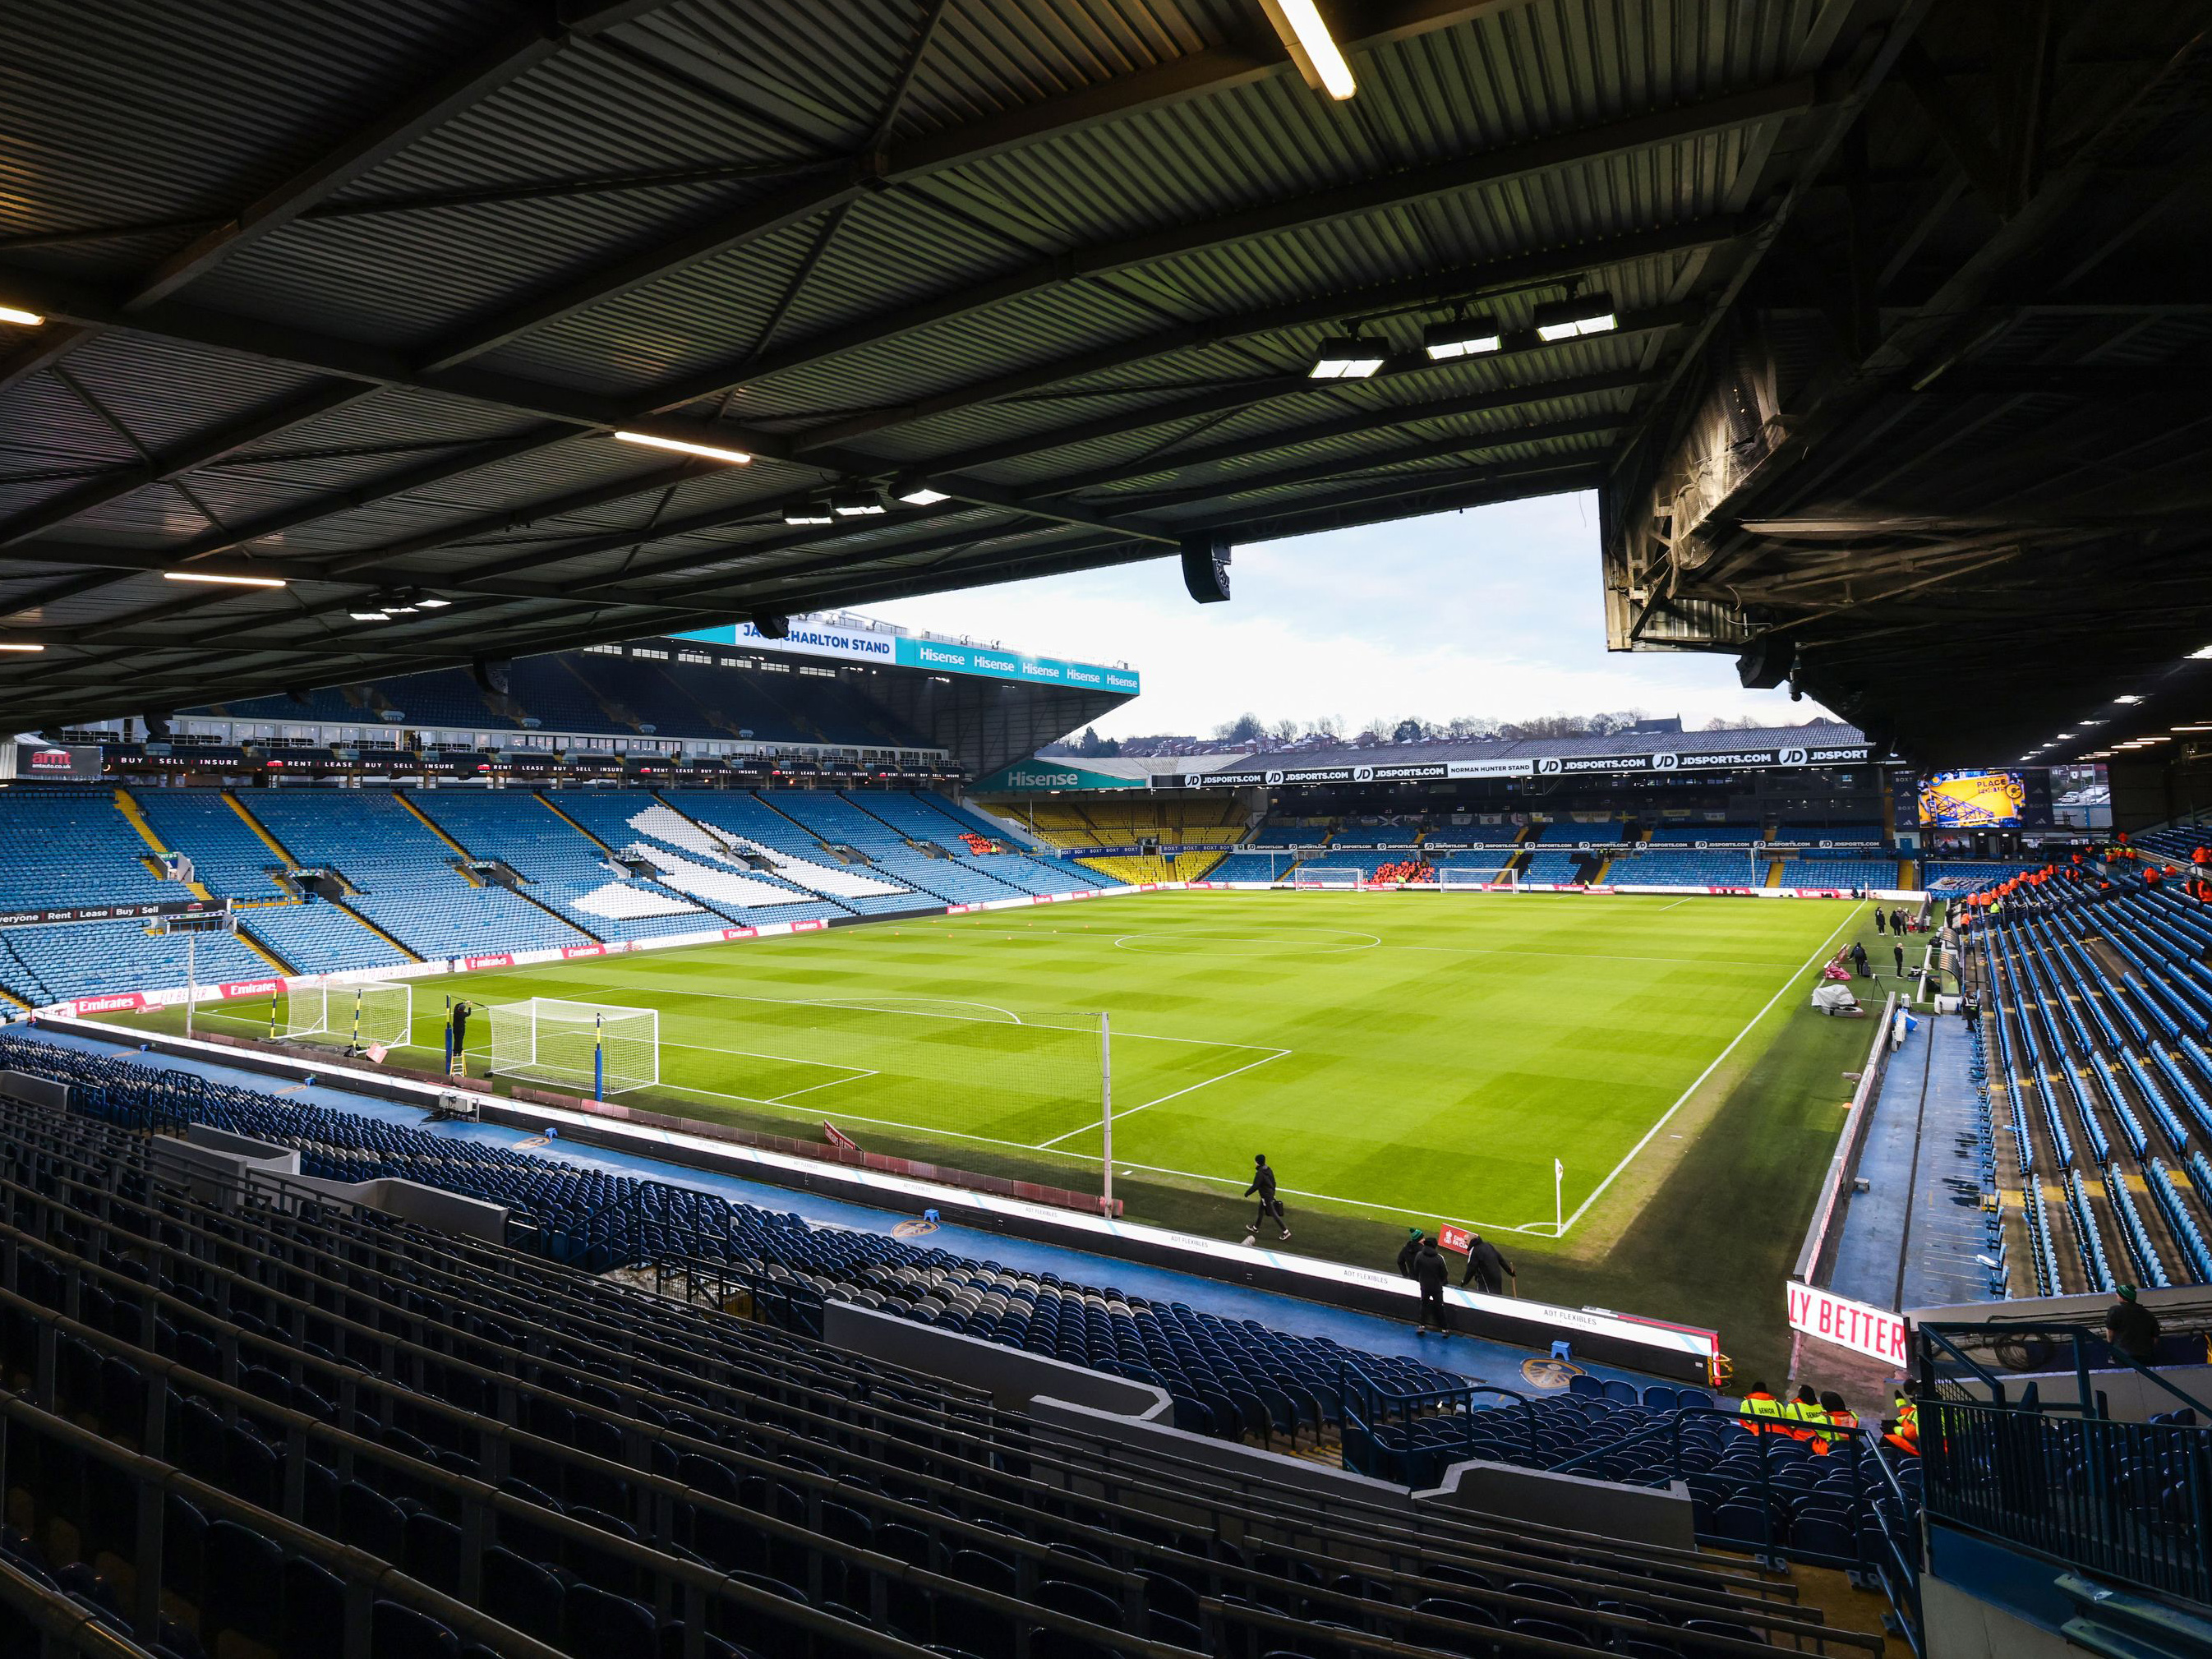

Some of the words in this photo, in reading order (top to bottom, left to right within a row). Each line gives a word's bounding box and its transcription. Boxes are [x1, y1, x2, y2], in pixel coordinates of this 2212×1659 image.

[852, 638, 890, 654] STAND
[919, 647, 965, 666] Hisense
[974, 655, 1015, 672] Hisense
[1022, 661, 1060, 678] Hisense
[1067, 668, 1100, 684] Hisense
[1107, 674, 1138, 689] Hisense
[32, 751, 71, 764] amt
[1565, 758, 1646, 770] JDSPORTS.COM
[1681, 753, 1772, 765] JDSPORTS.COM
[1285, 771, 1348, 781] JDSPORTS.COM
[1375, 767, 1445, 777] JDSPORTS.COM
[1007, 772, 1078, 786] Hisense
[1202, 775, 1260, 784] JDSPORTS.COM
[1977, 779, 2006, 787] PLACE
[48, 911, 71, 919] Rent
[80, 910, 108, 919] Lease
[116, 908, 134, 916] Buy
[141, 906, 159, 914] Sell
[568, 947, 599, 958] Emirates
[471, 956, 507, 969] Emirates
[231, 982, 277, 996] Emirates
[79, 997, 134, 1012] Emirates
[1357, 1272, 1388, 1284] FLEXIBLES
[1544, 1309, 1557, 1318] ADT
[1560, 1311, 1597, 1325] FLEXIBLES
[1789, 1289, 1812, 1326] LY
[1818, 1298, 1906, 1361] BETTER
